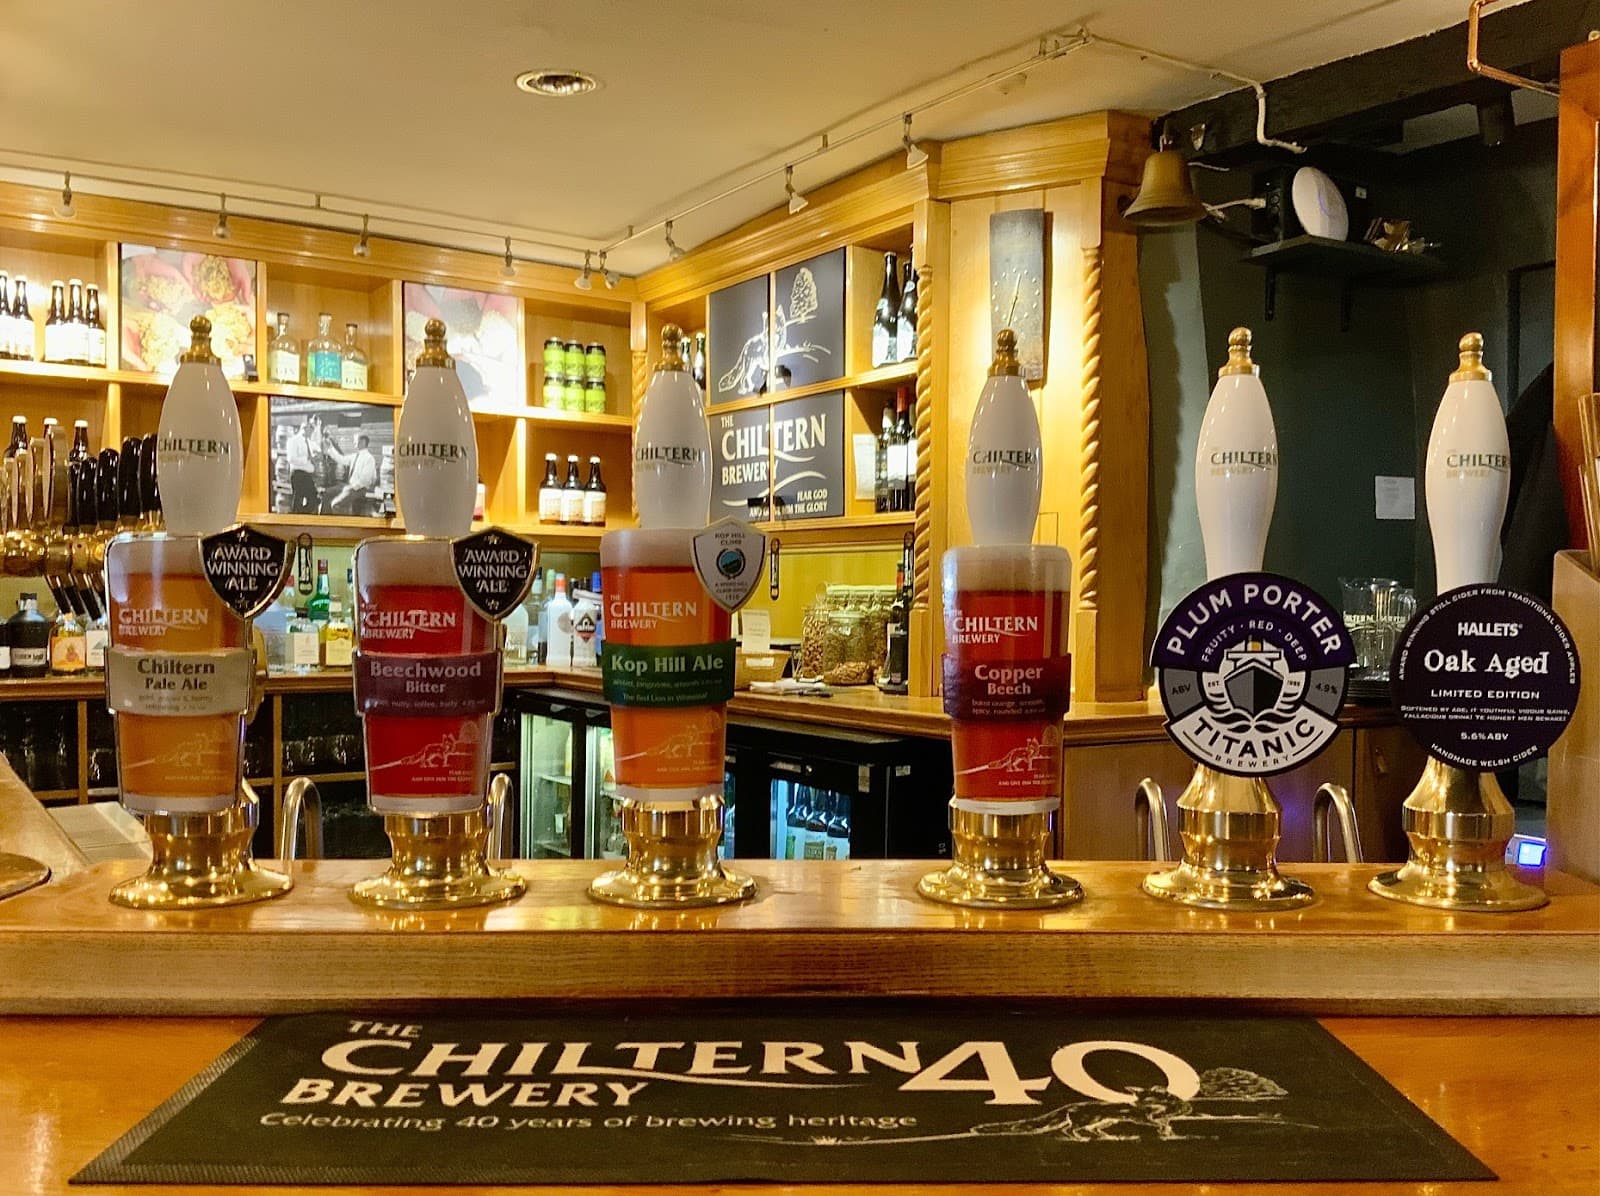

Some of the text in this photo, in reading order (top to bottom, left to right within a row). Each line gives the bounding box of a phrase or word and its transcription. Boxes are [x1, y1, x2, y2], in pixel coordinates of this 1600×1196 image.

[721, 415, 734, 427] THE
[722, 414, 826, 461] CHILTERN
[722, 460, 779, 486] BREWERY
[797, 488, 828, 501] FEAR GOD
[794, 503, 805, 514] THE
[807, 501, 828, 513] GLORY
[214, 547, 271, 561] AWARD
[465, 549, 520, 563] AWARD
[207, 561, 279, 577] WINNING
[458, 564, 527, 579] WINNING
[227, 577, 258, 591] ALE
[477, 579, 508, 593] ALE
[119, 608, 208, 625] CHILTERN
[610, 602, 697, 617] CHILTERN
[366, 610, 456, 627] CHILTERN
[611, 620, 657, 629] BREWERY
[953, 616, 1038, 632] CHILTERN
[1166, 583, 1342, 656] PLUM PORTER
[1430, 600, 1451, 615] STILL
[1452, 589, 1478, 602] CIDER
[1481, 588, 1505, 596] FROM
[1508, 591, 1555, 625] TRADITIONAL
[1554, 624, 1571, 649] CIDER
[119, 625, 167, 636] BREWERY
[365, 628, 415, 640] BREWERY
[952, 634, 1000, 644] BREWERY
[1201, 620, 1307, 663] FRUITY RED DEEP
[137, 658, 215, 674] Chiltern
[370, 661, 481, 678] Beechwood
[611, 654, 723, 676] Kop Hill Ale
[1424, 649, 1549, 679] Oak Aged
[974, 664, 1043, 684] Copper
[145, 678, 207, 690] Pale Ale
[406, 681, 446, 693] Bitter
[988, 683, 1031, 695] Beech
[1172, 684, 1191, 695] ABV
[1208, 680, 1220, 688] EST
[1315, 683, 1337, 695] 4.9%
[1430, 688, 1540, 700] LIMITED EDITION
[1194, 717, 1315, 758] TITANIC
[1215, 754, 1289, 768] BREWERY
[1431, 743, 1539, 767] HANDMADE WELSH CIDER
[347, 1019, 424, 1037] THE
[321, 1038, 1201, 1105] CHILTERN 40
[279, 1077, 649, 1107] BREWERY
[260, 1111, 918, 1132] Celebrating 40 years of brewing heritage
